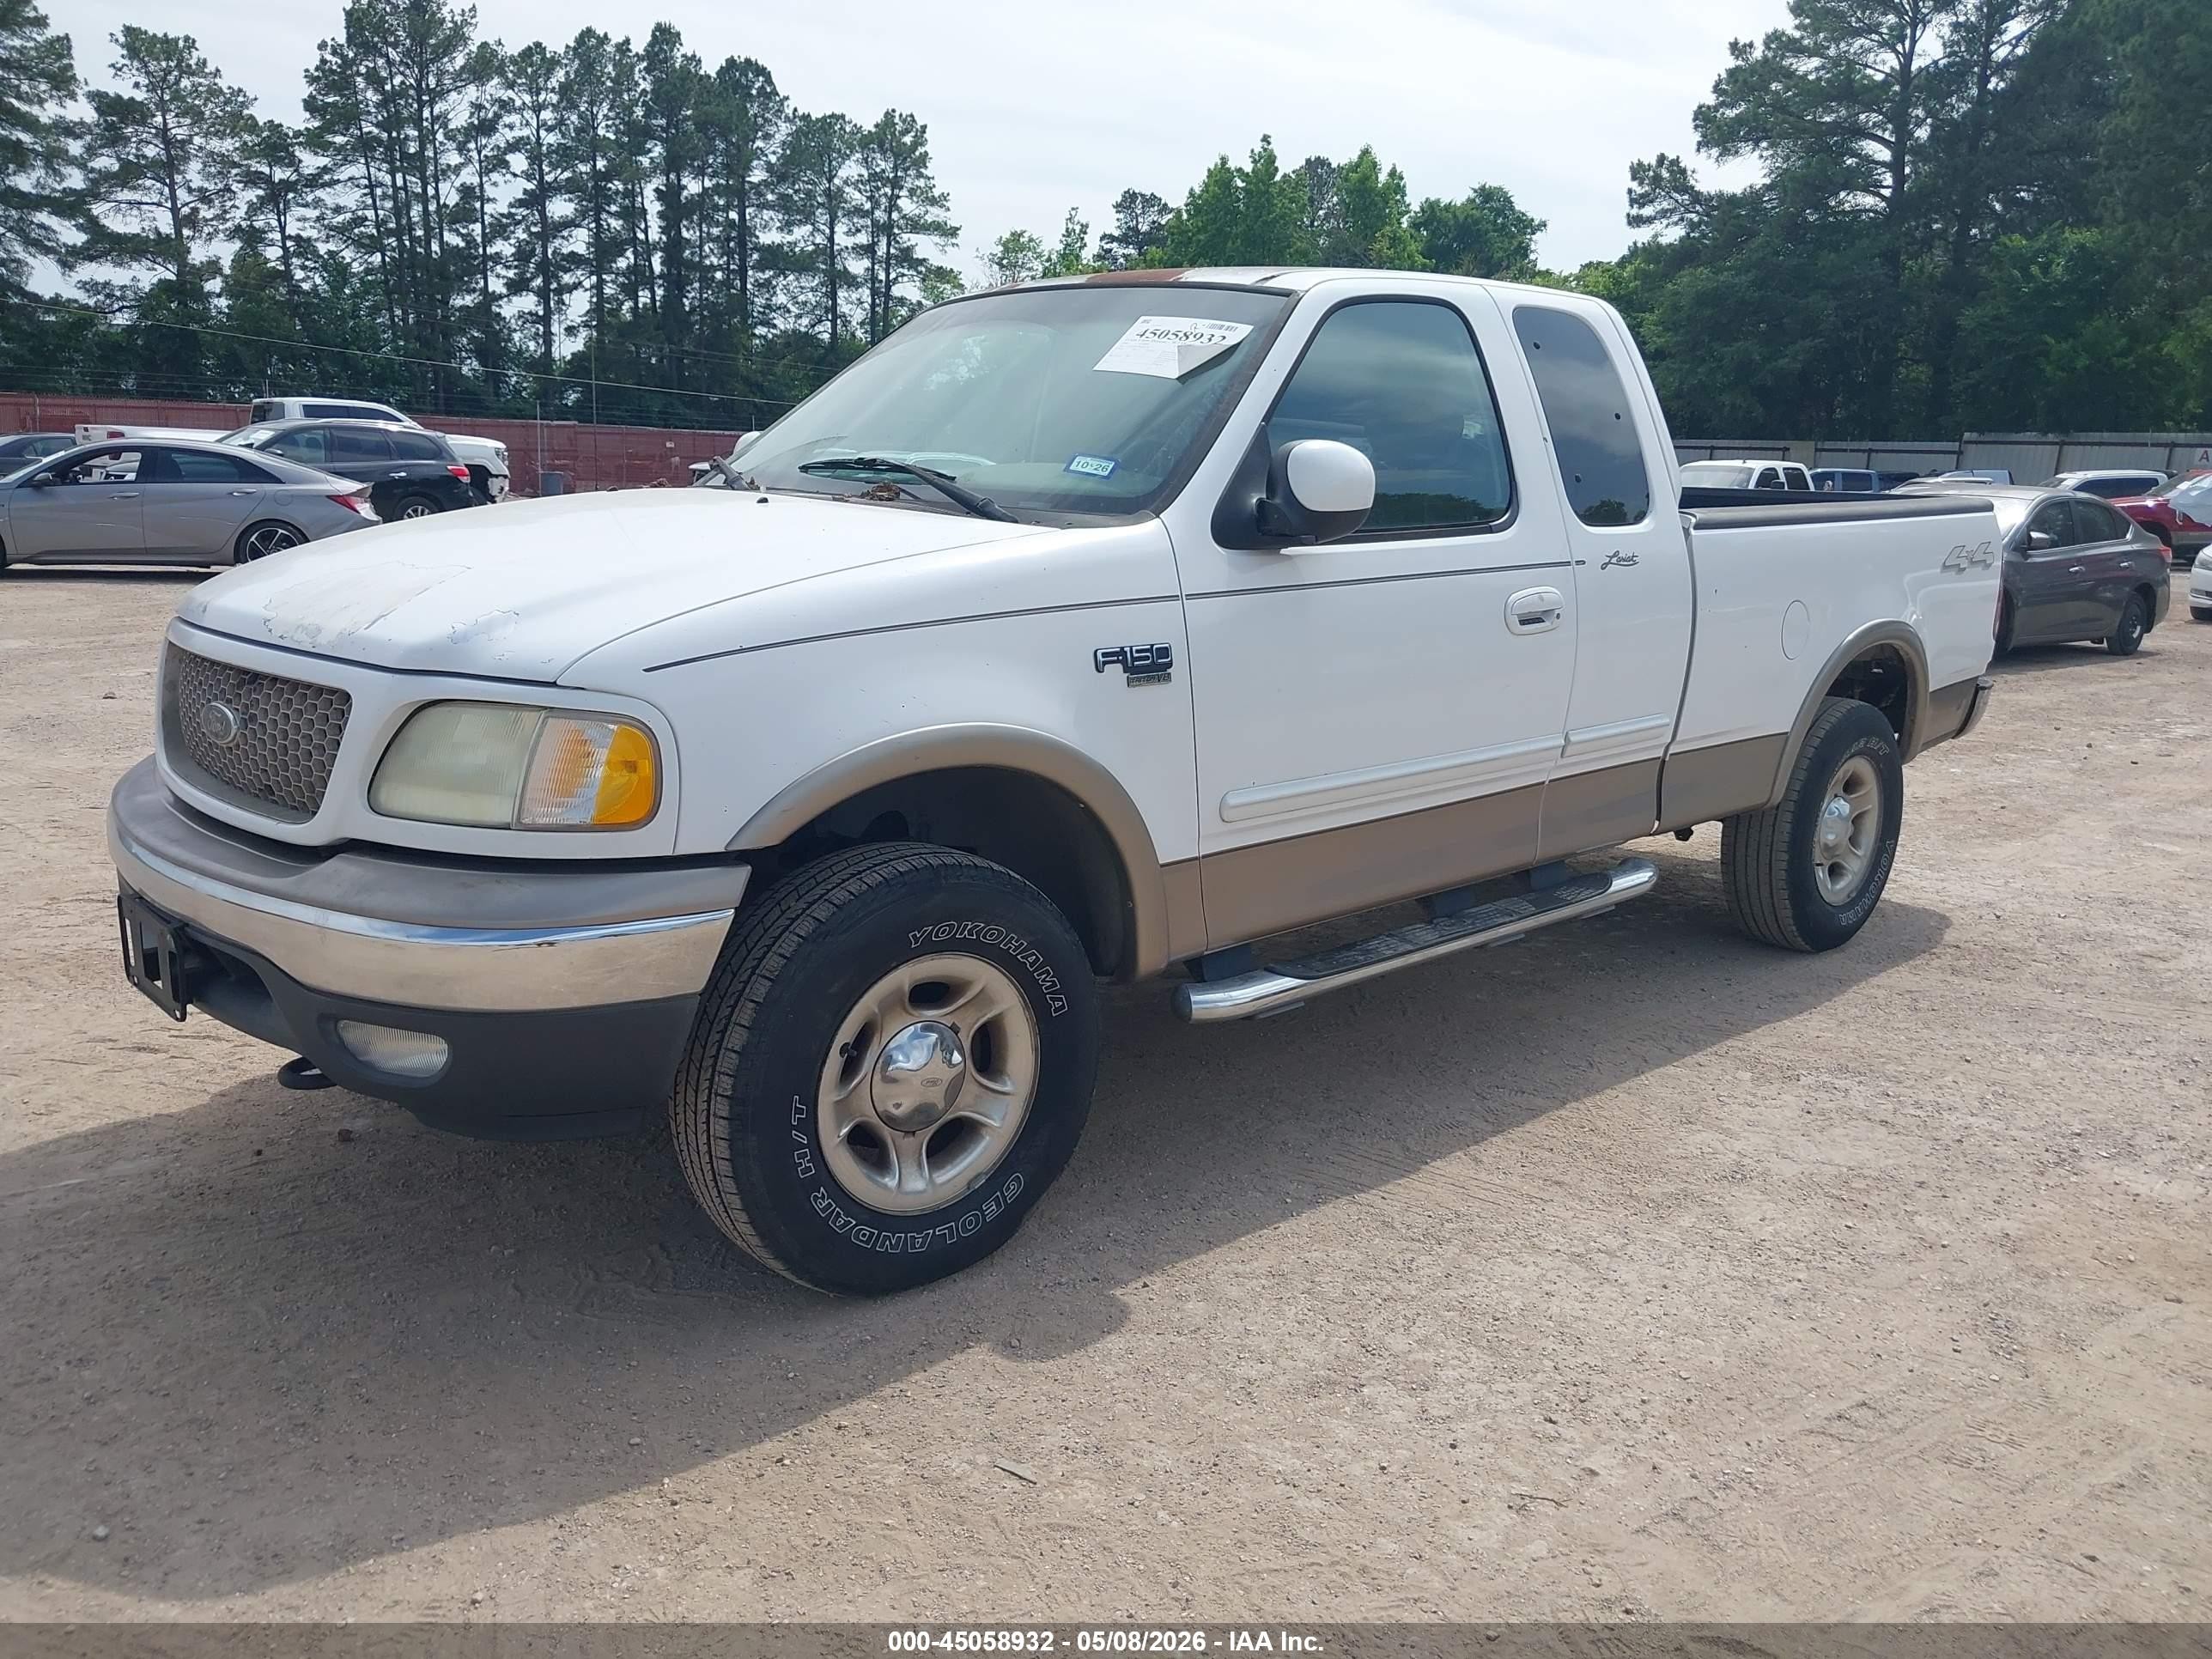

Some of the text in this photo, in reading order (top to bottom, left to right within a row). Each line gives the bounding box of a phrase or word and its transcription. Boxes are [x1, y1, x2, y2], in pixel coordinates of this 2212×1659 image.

[1136, 328, 1226, 344] 45058932
[1093, 464, 1109, 472] 26
[1600, 550, 1640, 571] Lariat
[908, 921, 1070, 1018] YOKOHAMA
[791, 1095, 1024, 1254] GEOLANDAR H/T
